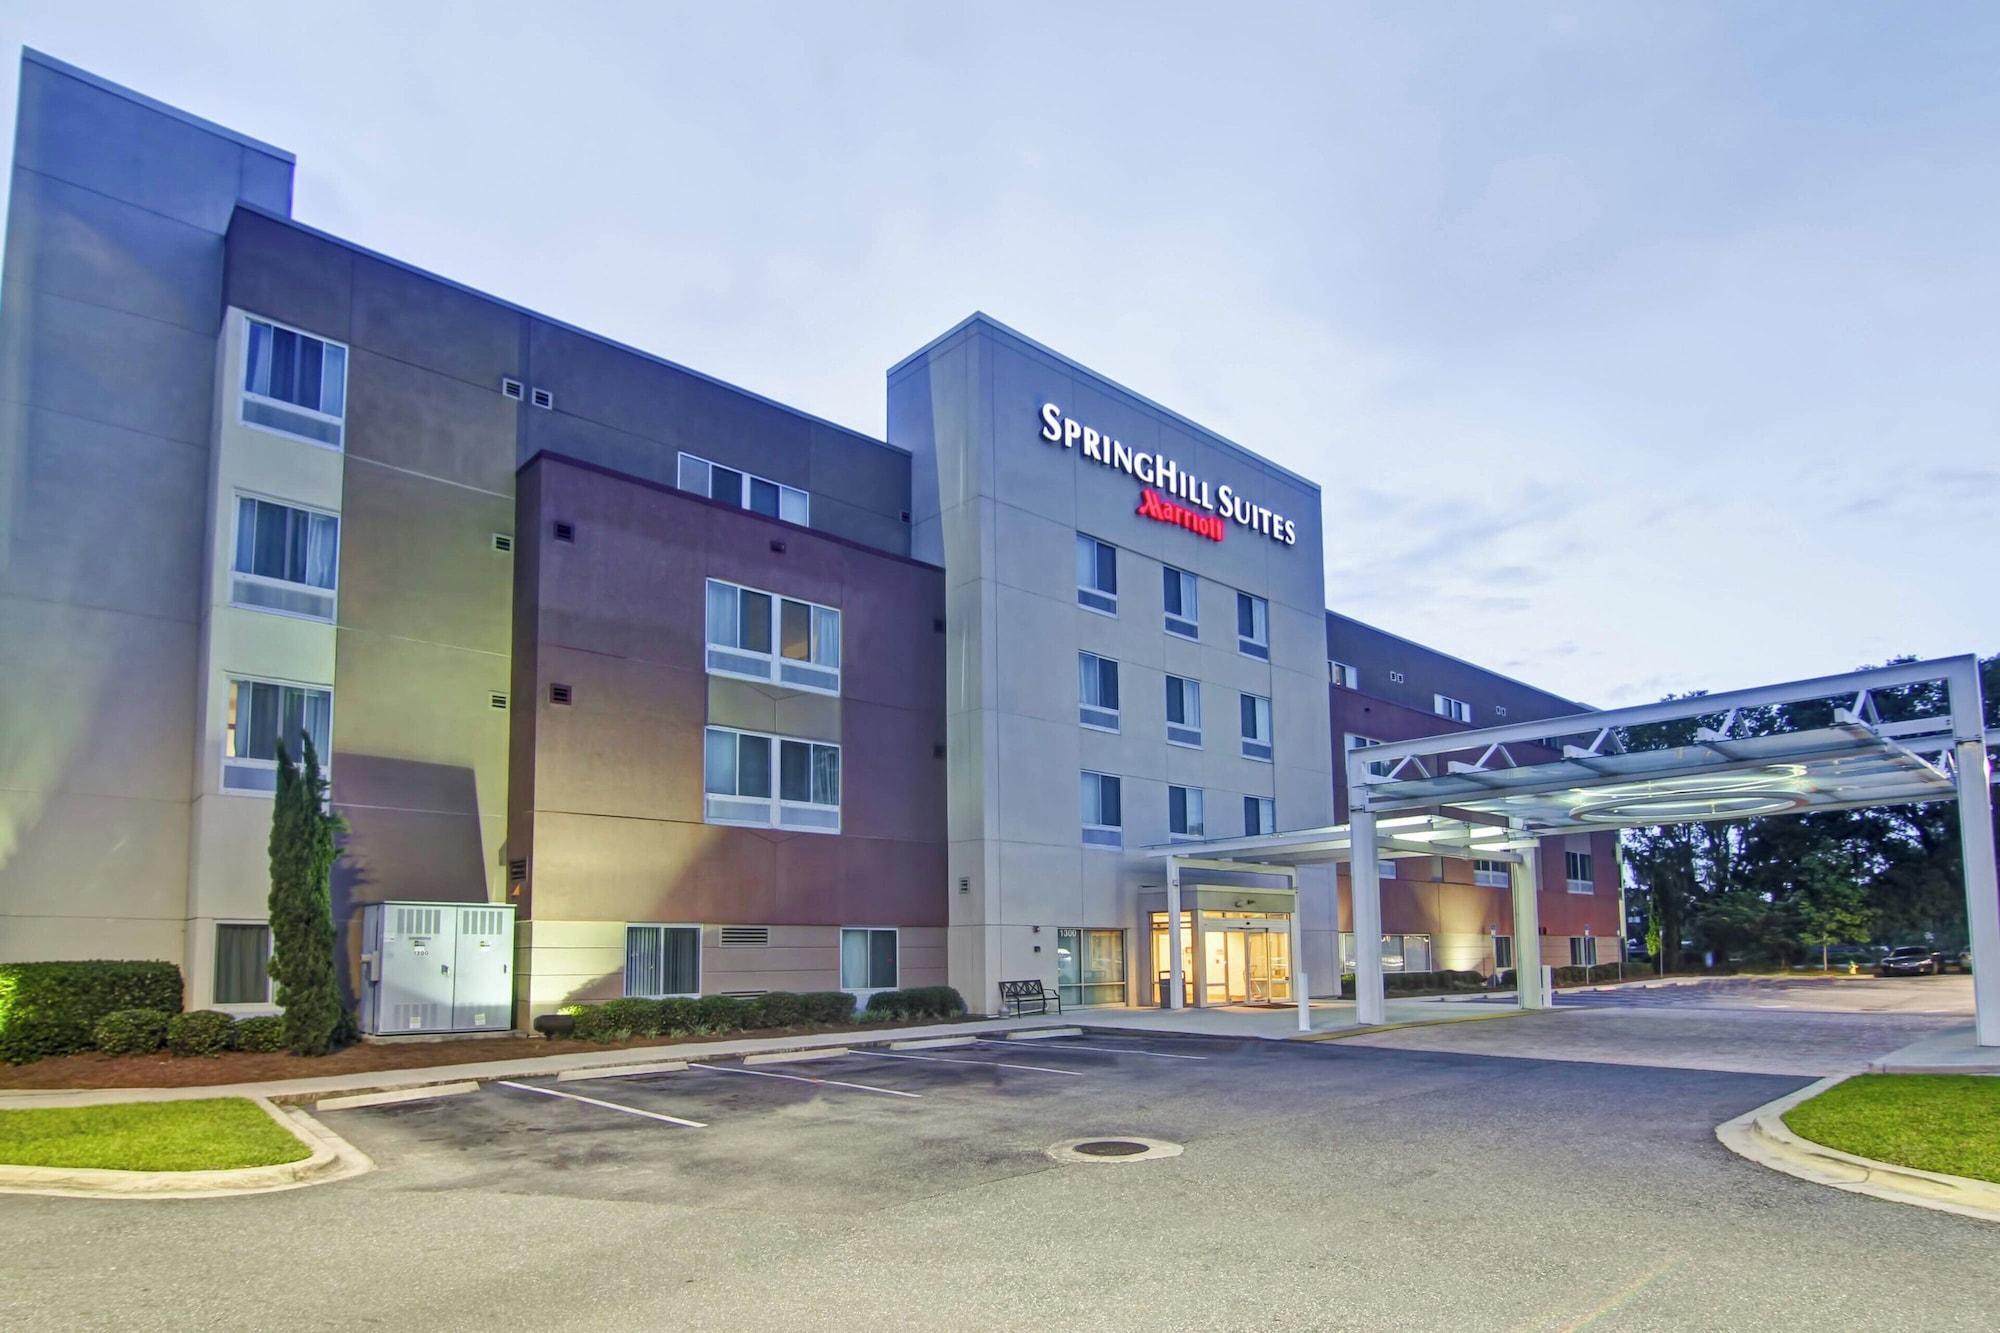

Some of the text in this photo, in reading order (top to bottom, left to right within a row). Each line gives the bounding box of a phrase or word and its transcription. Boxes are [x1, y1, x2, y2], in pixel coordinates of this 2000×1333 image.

[1041, 403, 1296, 545] SPRINGHILL SUITES
[1136, 488, 1224, 541] Marriott
